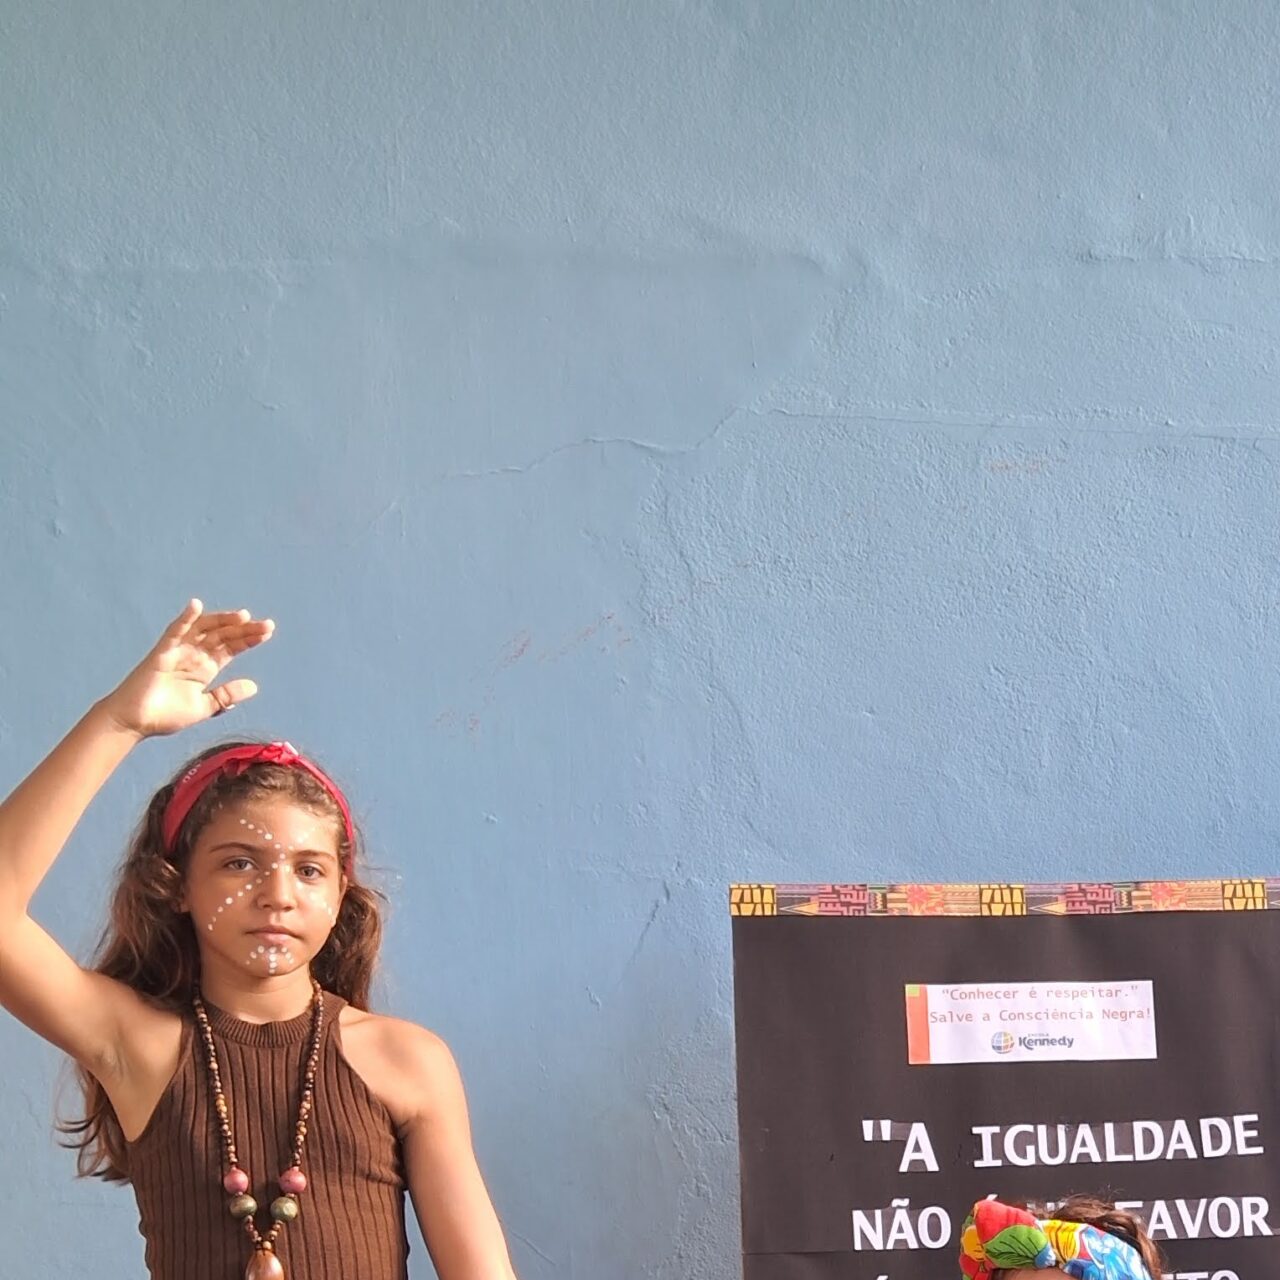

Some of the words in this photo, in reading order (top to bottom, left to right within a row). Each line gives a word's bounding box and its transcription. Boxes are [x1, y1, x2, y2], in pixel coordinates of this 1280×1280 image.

[1028, 986, 1038, 999] é
[929, 1011, 974, 1023] Salve
[982, 1012, 991, 1022] a
[999, 1008, 1094, 1022] Consciência
[1102, 1008, 1151, 1023] Negra!
[1018, 1035, 1075, 1051] Kennedy
[972, 1114, 1265, 1168] IGUALDADE
[851, 1198, 952, 1252] NÃO
